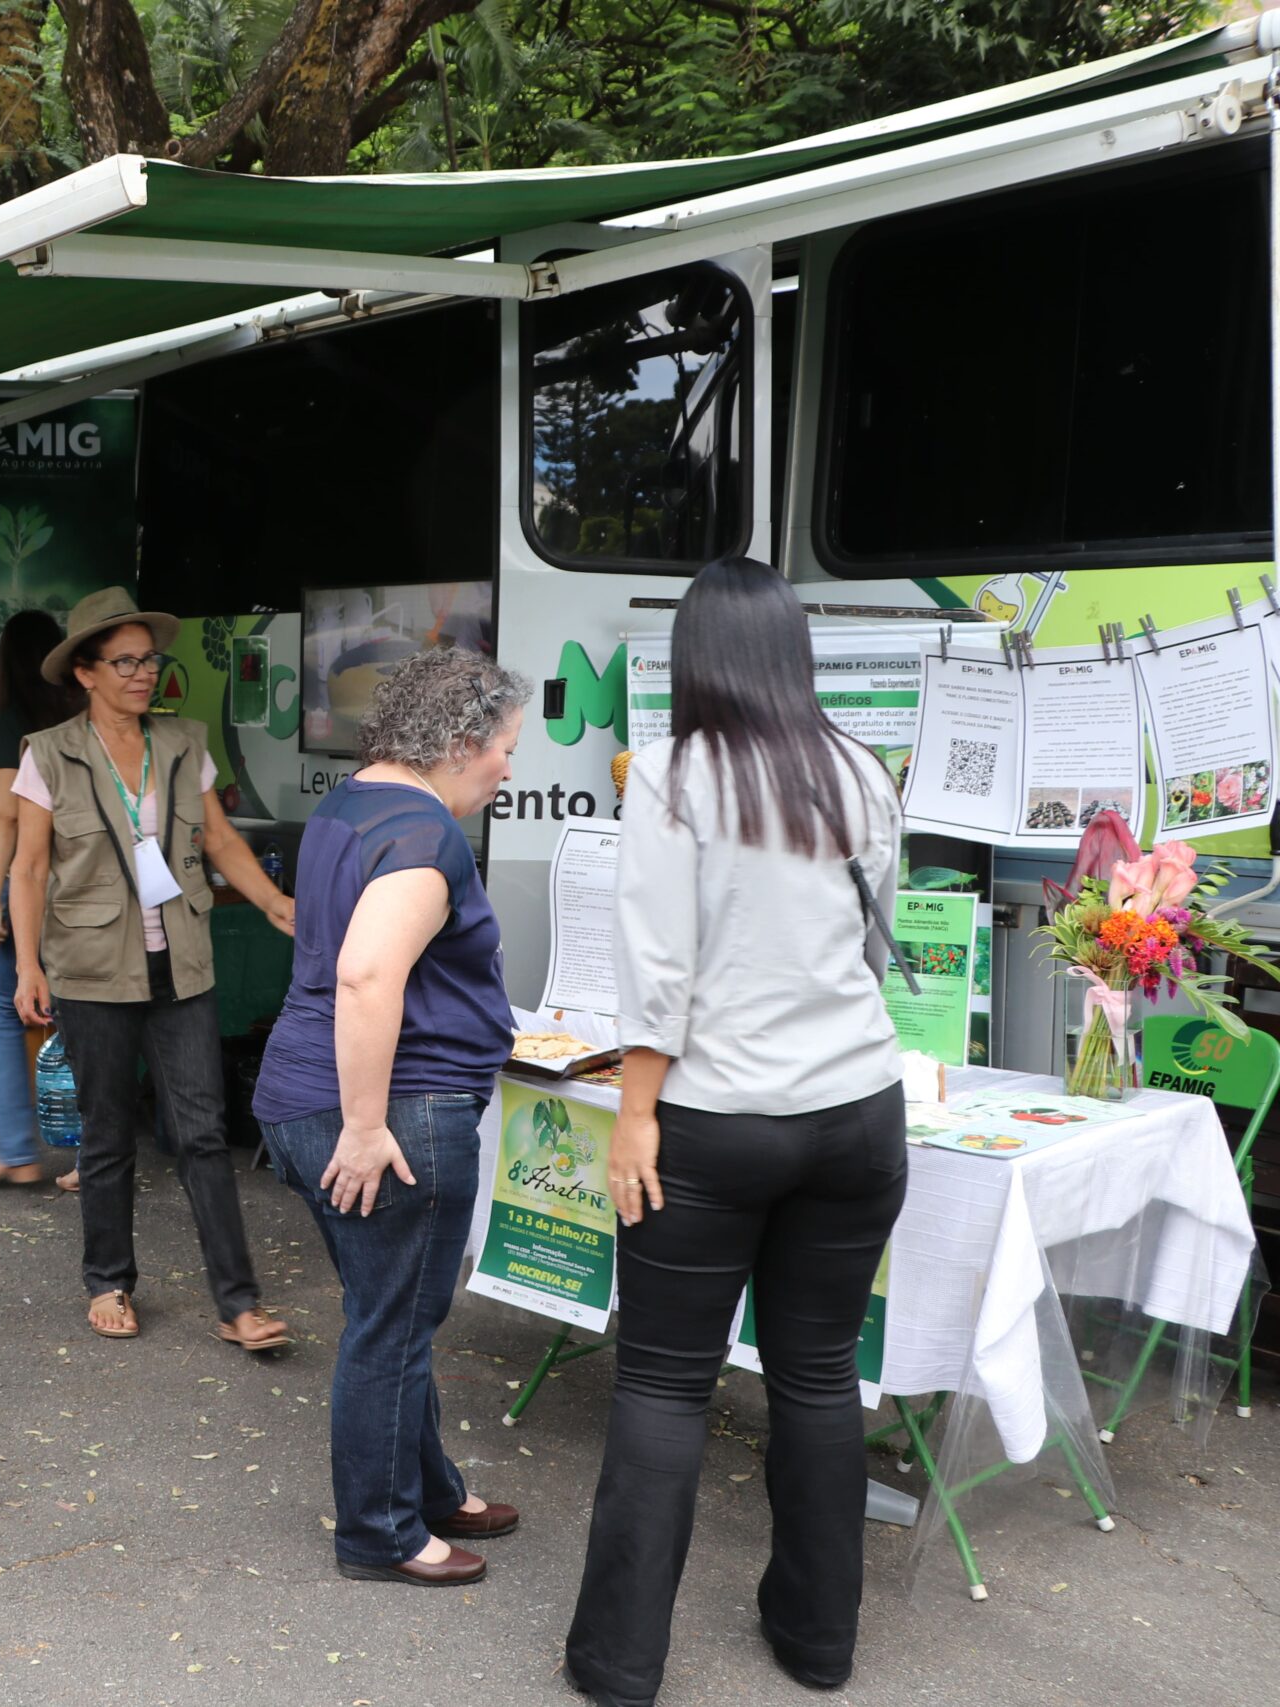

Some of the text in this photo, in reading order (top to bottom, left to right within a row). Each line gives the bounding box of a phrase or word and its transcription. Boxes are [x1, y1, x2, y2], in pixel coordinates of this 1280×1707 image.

[1, 458, 102, 470] Agropecuária
[1179, 642, 1217, 658] EPAMIG
[962, 665, 993, 675] EPAMIG
[1059, 665, 1093, 675] EPAMIG
[817, 694, 872, 706] néficos
[833, 710, 862, 719] ajudam
[876, 709, 904, 717] reduzir
[852, 721, 884, 729] gratuito
[907, 902, 944, 911] EPAMIG
[1195, 1032, 1233, 1061] 50
[1148, 1071, 1216, 1098] EPAMIG
[508, 1210, 599, 1246] 1 a 3 de julho/25
[532, 1243, 567, 1259] Informações
[507, 1261, 582, 1293] INSCREVA-SE!
